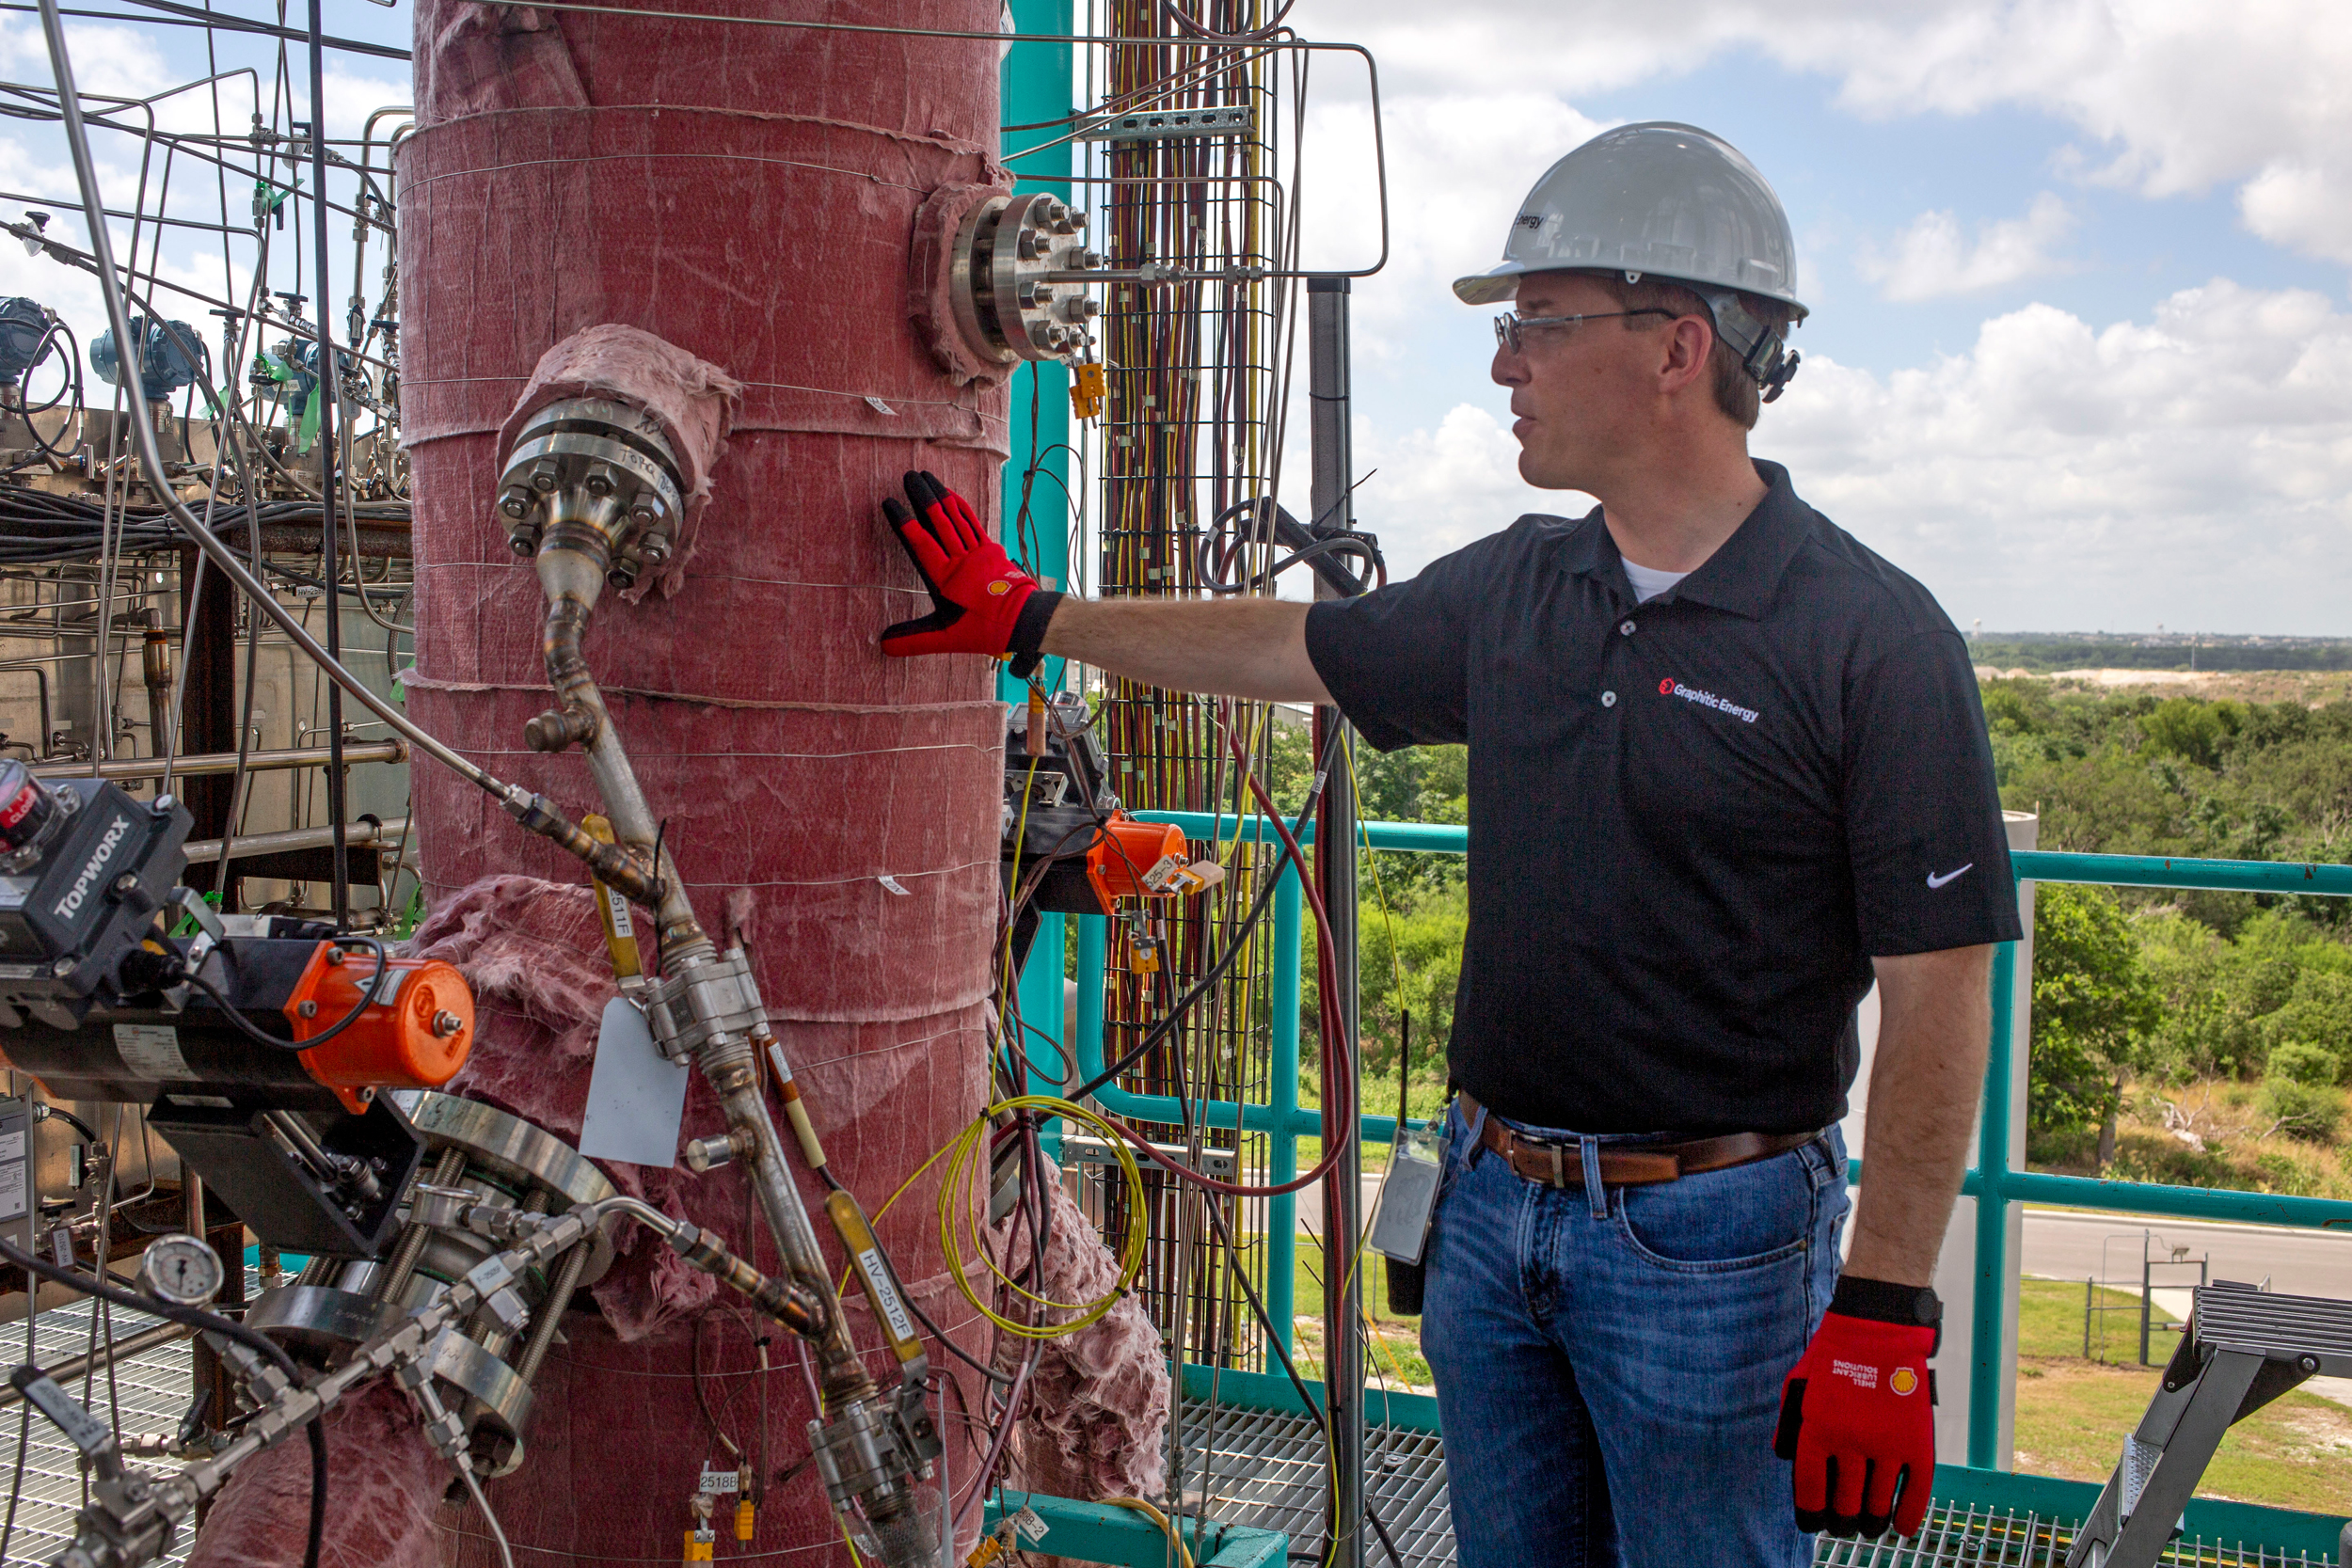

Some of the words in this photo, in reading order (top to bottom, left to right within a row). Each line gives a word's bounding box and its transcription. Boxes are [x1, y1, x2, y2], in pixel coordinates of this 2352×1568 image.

[1674, 683, 1720, 708] Graphitic
[1718, 698, 1759, 723] Energy
[53, 814, 131, 919] TOPWORX
[863, 1253, 911, 1335] HV-2512F
[1832, 1368, 1878, 1382] LUBRICANT
[1833, 1359, 1879, 1374] SOLUTIONS
[1852, 1377, 1877, 1389] SHELL
